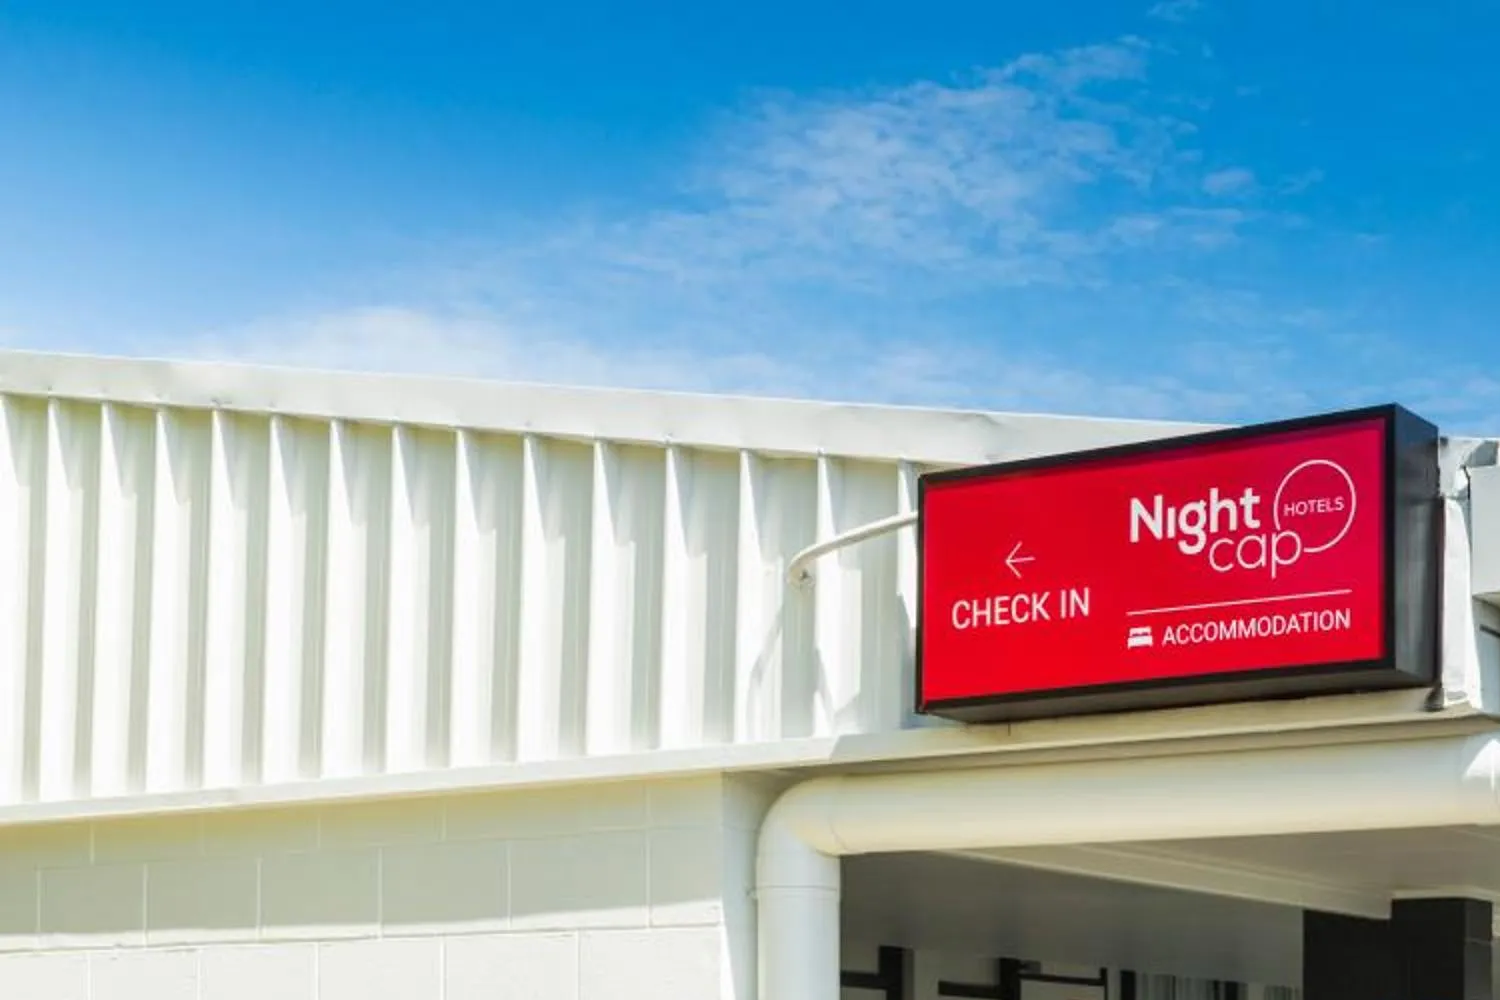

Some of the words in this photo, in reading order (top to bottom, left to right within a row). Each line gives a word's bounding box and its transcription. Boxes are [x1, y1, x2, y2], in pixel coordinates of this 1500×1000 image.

[1129, 486, 1261, 554] Night
[1283, 496, 1345, 517] HOTELS
[1208, 529, 1302, 579] cap
[951, 590, 1051, 630] CHECK
[1060, 587, 1090, 620] IN
[1161, 609, 1351, 646] ACCOMMODATION
